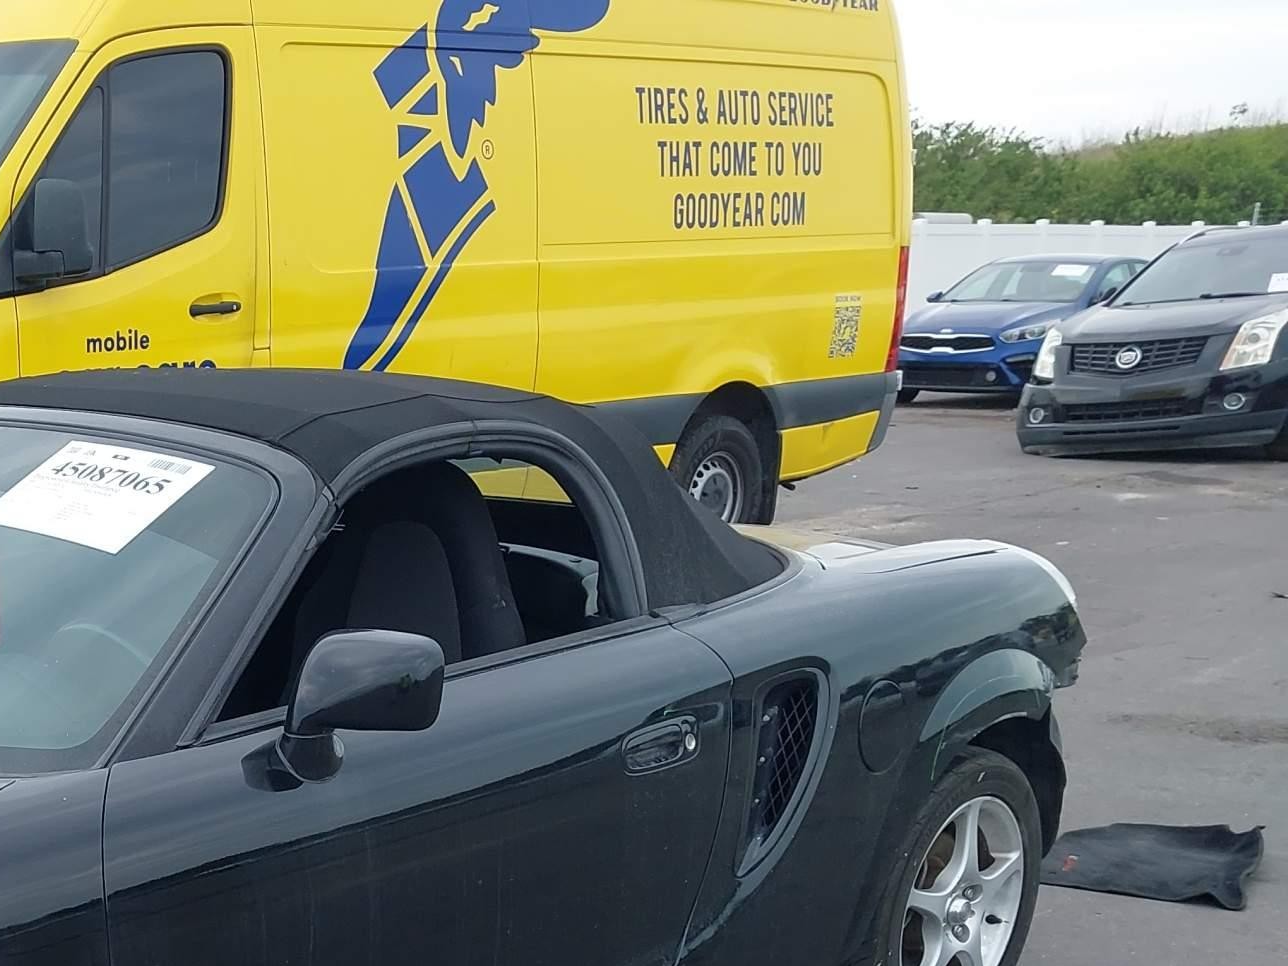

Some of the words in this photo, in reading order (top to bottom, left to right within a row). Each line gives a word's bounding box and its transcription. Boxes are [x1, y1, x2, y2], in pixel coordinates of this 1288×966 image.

[789, 0, 879, 12] YEAR
[635, 87, 689, 124] TIRES
[696, 87, 709, 124] &
[716, 90, 761, 125] AUTO
[768, 91, 834, 127] SERVICE
[657, 141, 702, 177] THAT
[710, 141, 758, 177] COME
[765, 142, 785, 176] TO
[792, 141, 822, 176] YOU
[674, 192, 764, 229] GOODYEAR
[770, 192, 806, 226] COM
[86, 329, 150, 353] mobile
[50, 461, 173, 495] 45087065
